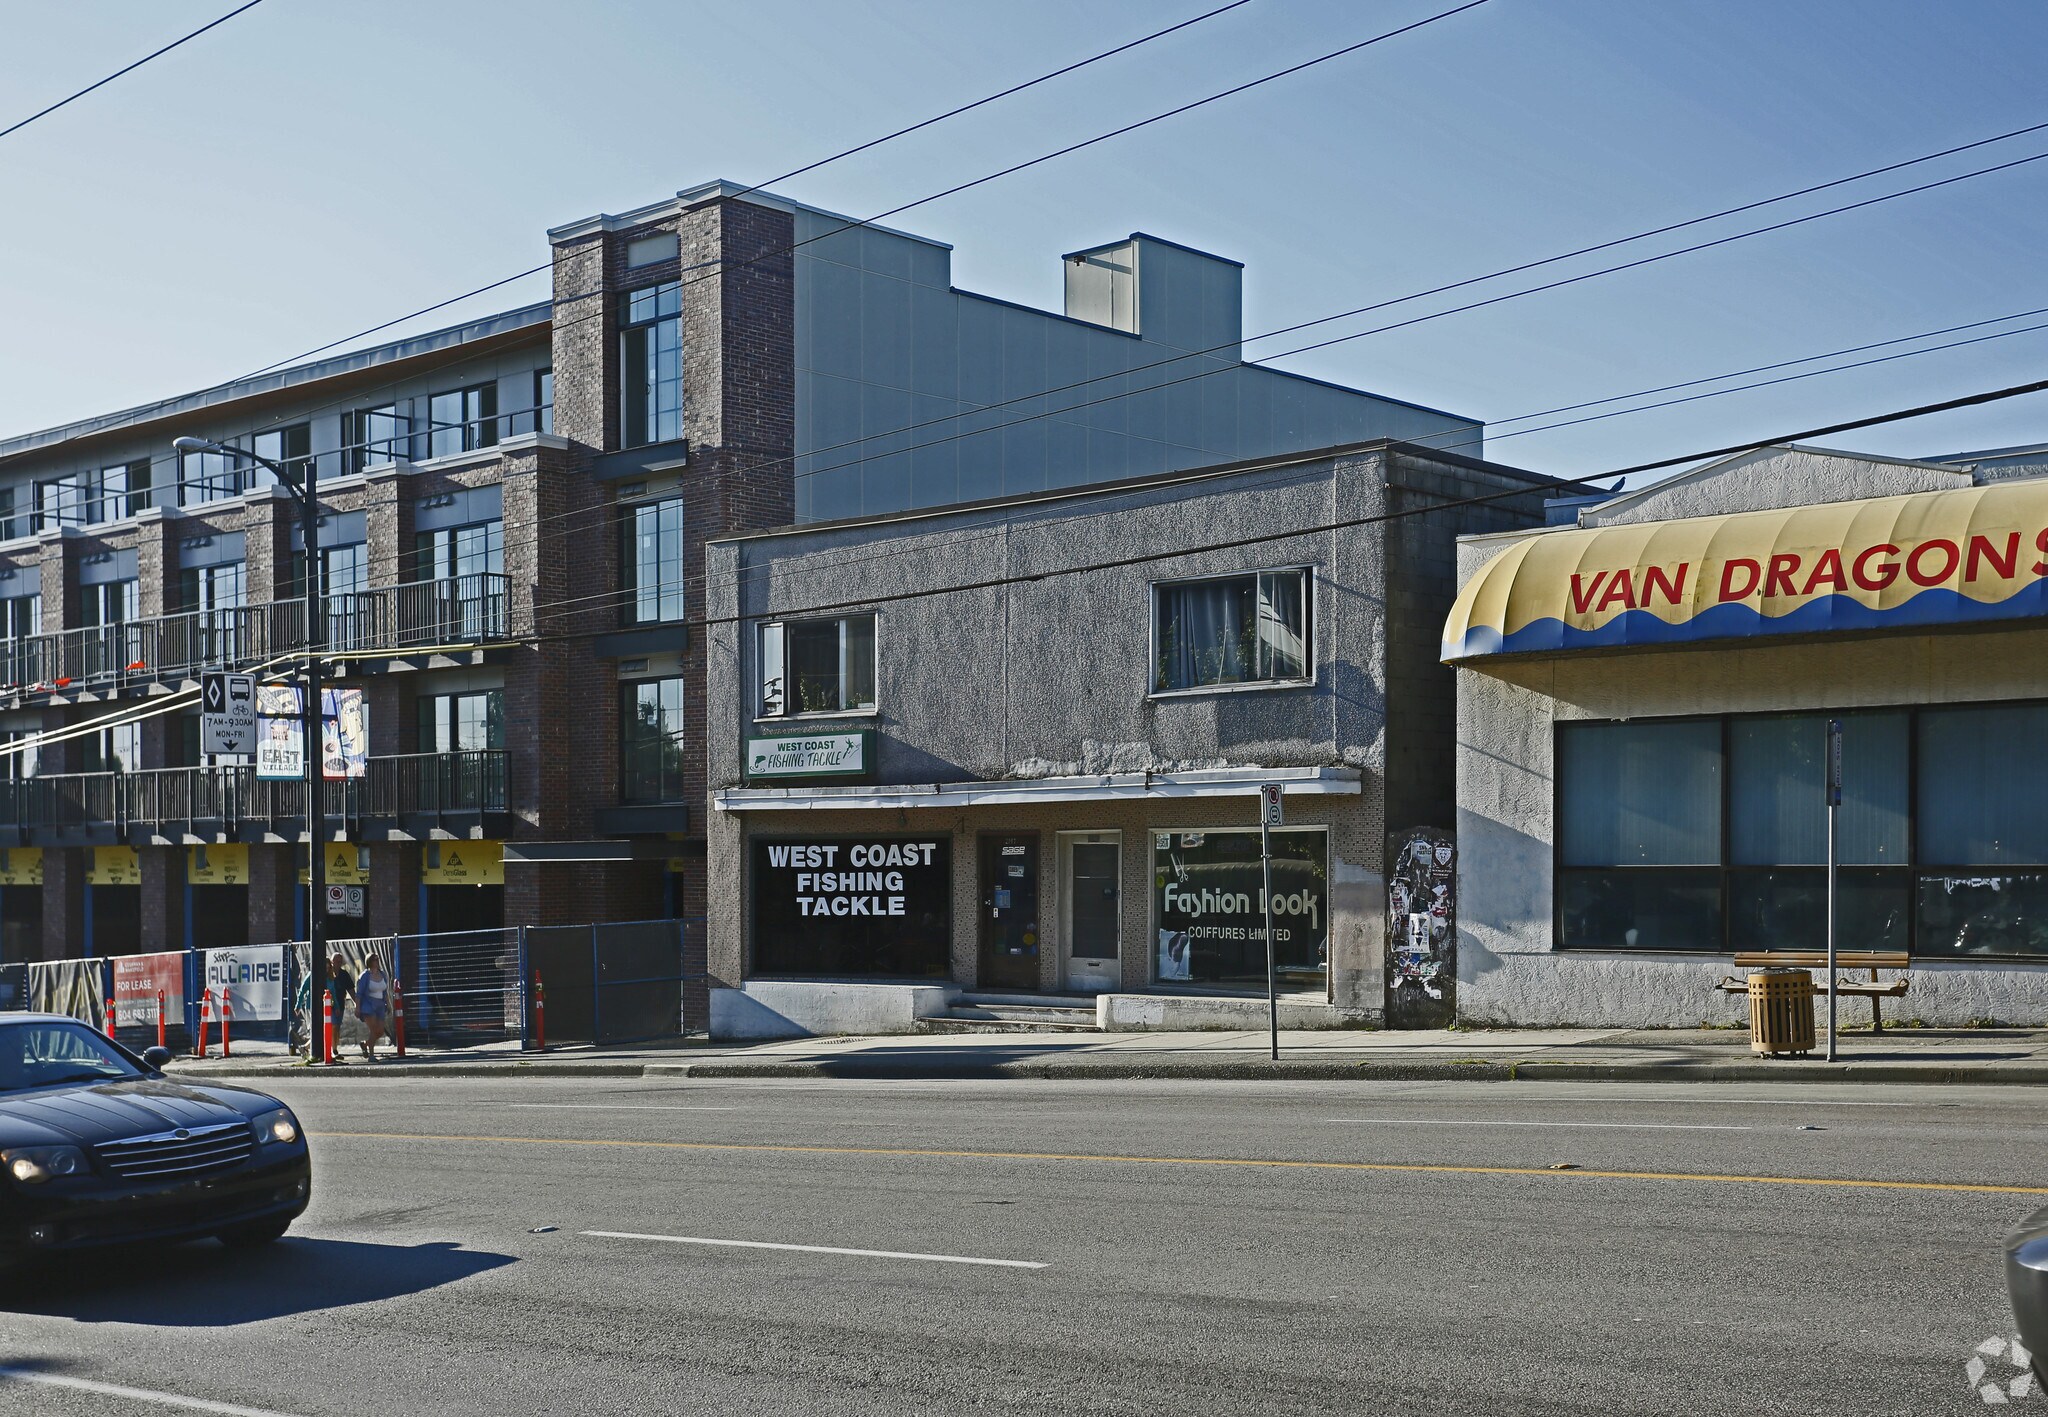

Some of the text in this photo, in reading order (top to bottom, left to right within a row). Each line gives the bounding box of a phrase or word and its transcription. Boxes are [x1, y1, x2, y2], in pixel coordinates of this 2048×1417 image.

[1570, 562, 1690, 615] VAN
[215, 730, 245, 738] MON-FRI
[777, 740, 835, 752] WEST COAST
[262, 749, 300, 764] EAST
[767, 751, 842, 768] FISHING TACKLE
[767, 842, 936, 868] WEST COAST
[443, 868, 467, 877] DensGlass
[796, 870, 904, 893] FISHING
[796, 895, 907, 917] TACKLE
[1164, 883, 1250, 918] Fashion
[1188, 926, 1291, 941] COIFFURES LIMTED
[208, 962, 281, 985] ALLAIRE
[116, 979, 152, 991] FOR LEASE
